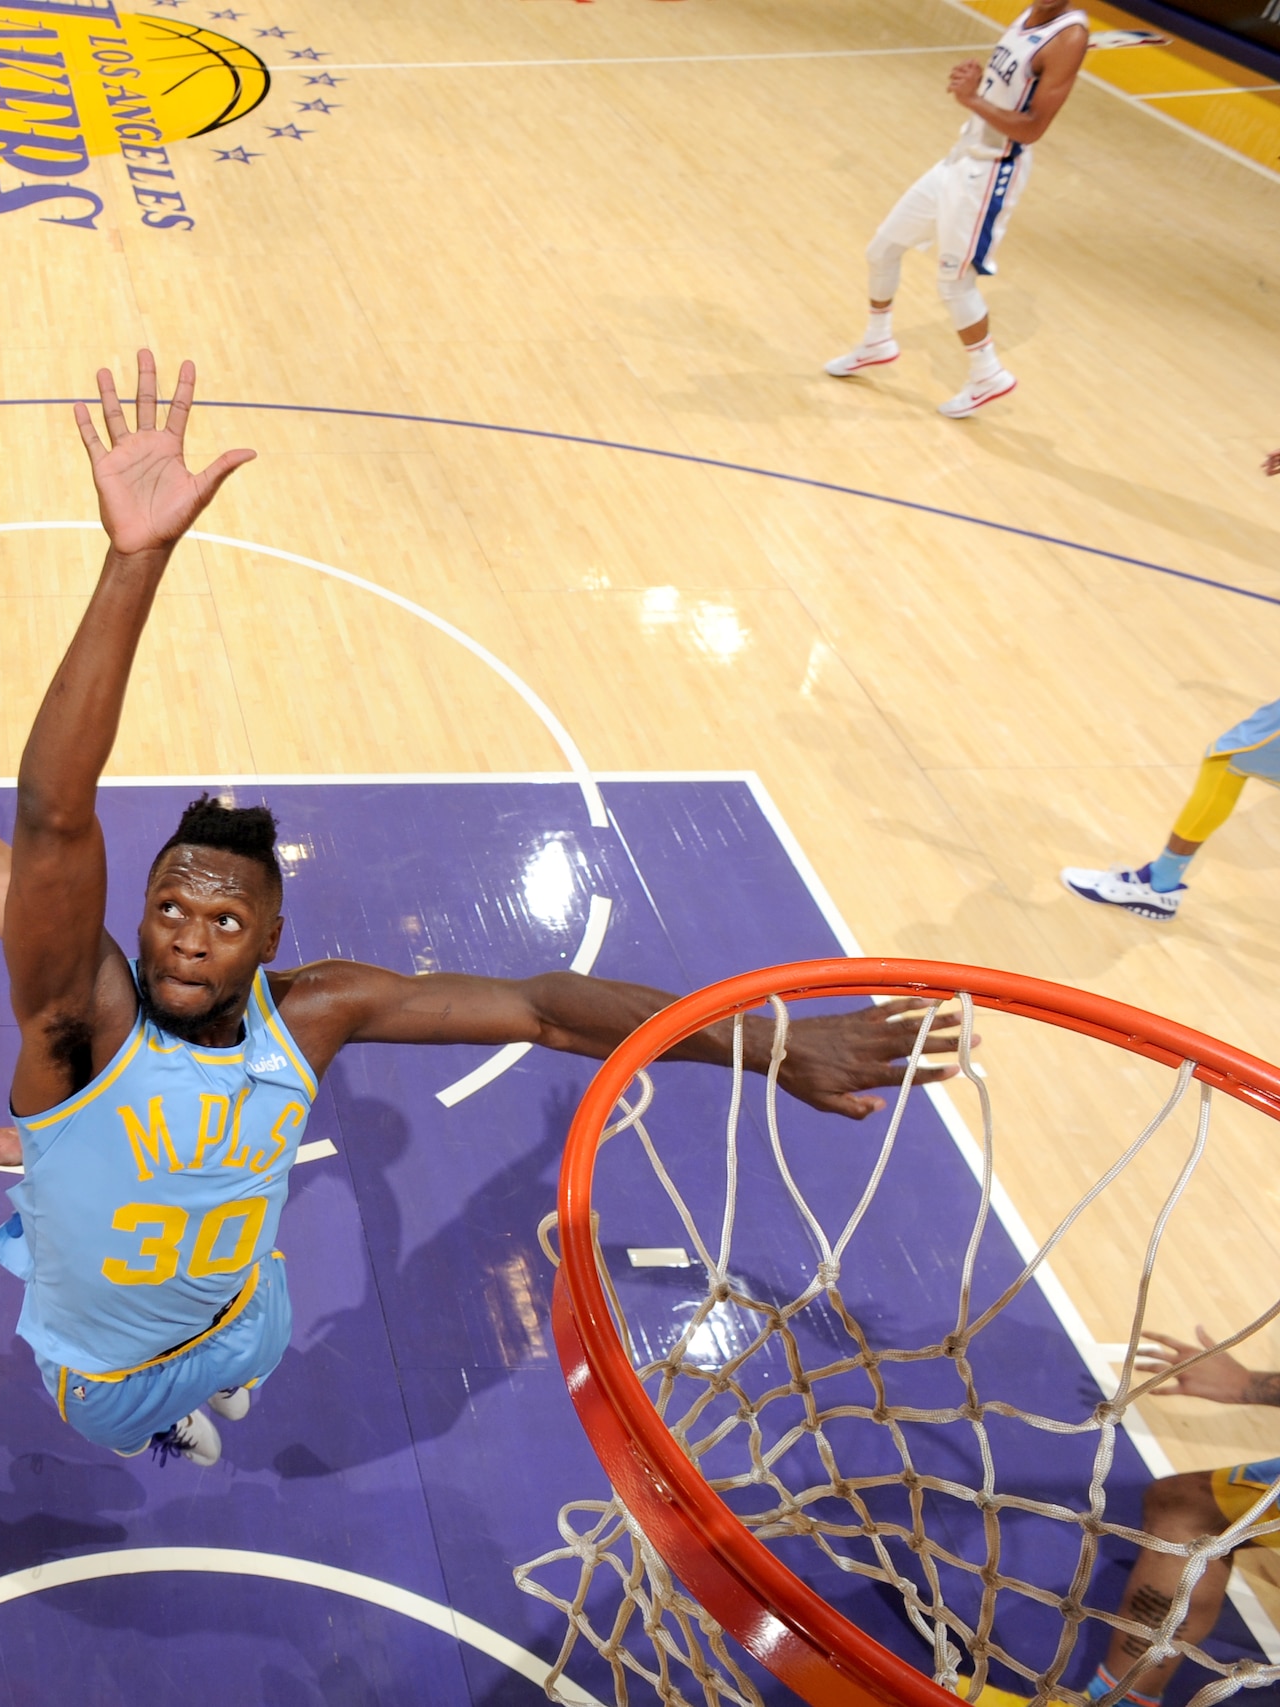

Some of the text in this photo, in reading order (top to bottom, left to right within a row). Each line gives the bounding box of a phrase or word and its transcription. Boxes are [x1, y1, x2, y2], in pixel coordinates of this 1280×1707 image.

[88, 35, 196, 232] LOS ANGELES
[247, 1053, 288, 1073] wish
[101, 1196, 269, 1286] 30
